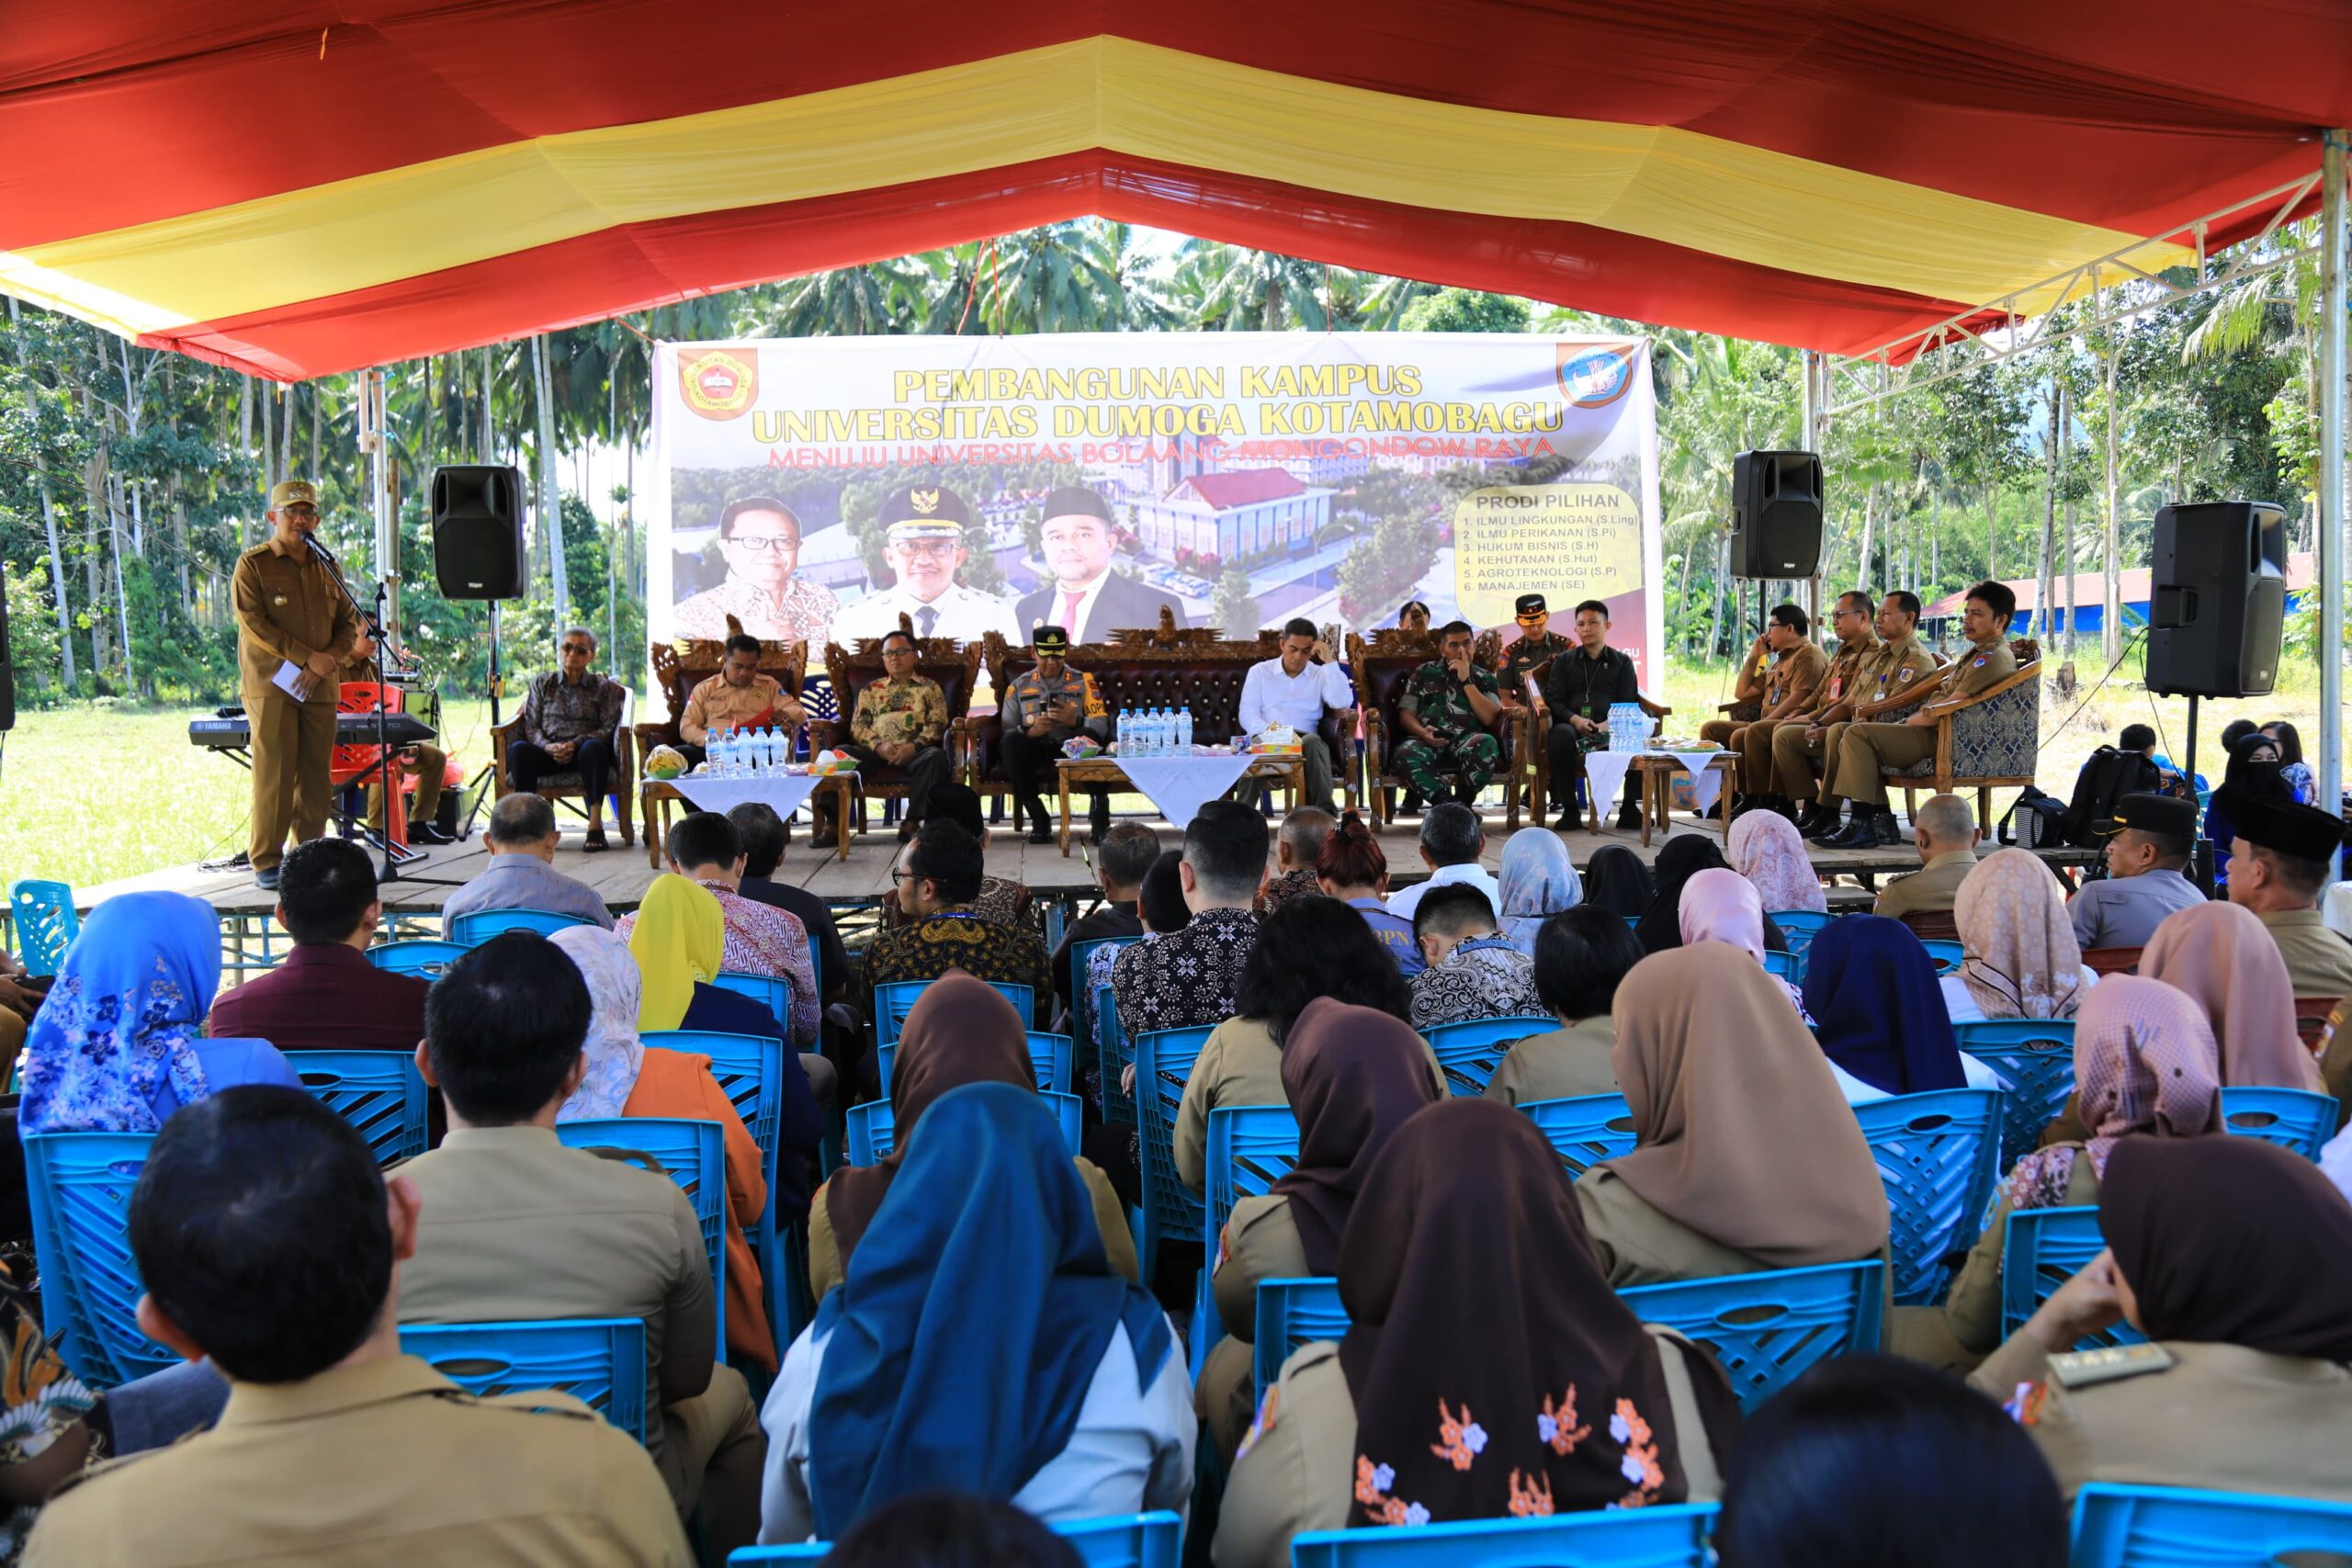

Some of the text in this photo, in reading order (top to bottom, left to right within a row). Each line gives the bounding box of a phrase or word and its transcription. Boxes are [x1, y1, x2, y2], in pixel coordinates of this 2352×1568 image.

[894, 364, 1422, 403] PEMBANGUNAN KAMPUS
[752, 400, 1563, 443] UNIVERSITAS DUMOGA KOTAMOBAGU
[768, 436, 1556, 469] MENUJU UNIVERSITAS BOLAANG MONGONDOW RAYA
[1476, 493, 1620, 509] PRODI PILIHAN
[1463, 514, 1638, 526] 1. ILMU LINGKUNGAN (S.Ling)
[1463, 526, 1616, 539] 2. ILMU PERIKANAN (S.Pi)
[1463, 540, 1599, 552] 3. HUKUM BISNIS (S.H)
[1463, 554, 1598, 566] 4. KEHUTANAN (S.Hut)
[1464, 566, 1617, 579] 5. AGROTEKNOLOGI (S.P)
[1464, 580, 1586, 592] 6. MANAJEMEN (SE)
[204, 721, 232, 730] YAMAHA
